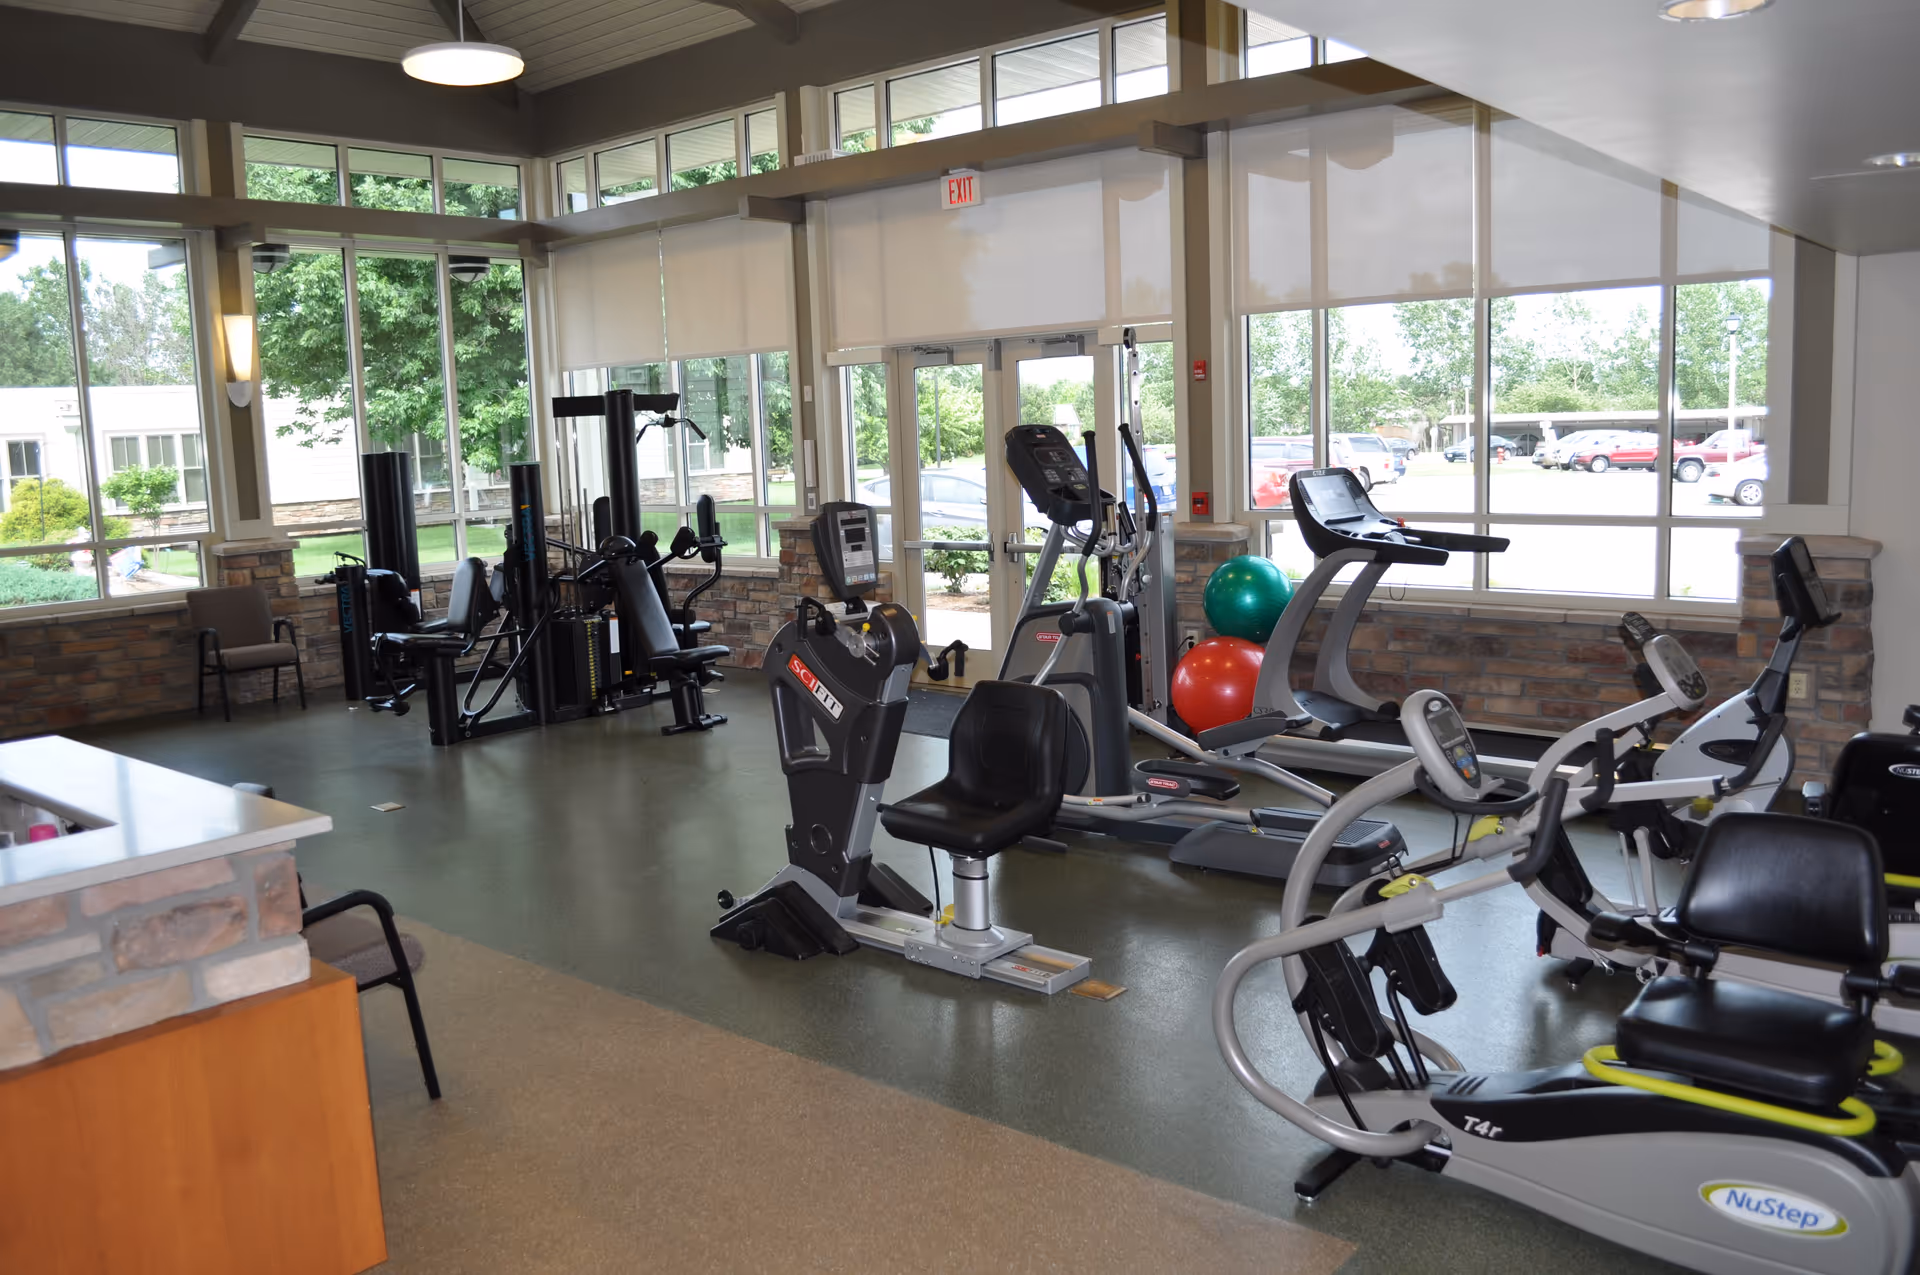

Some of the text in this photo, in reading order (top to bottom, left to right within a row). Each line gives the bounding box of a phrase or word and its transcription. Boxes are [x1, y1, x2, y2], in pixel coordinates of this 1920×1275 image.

[948, 176, 973, 205] EXIT
[341, 585, 354, 633] VECTRA
[791, 660, 841, 711] SCIFIT
[1464, 1115, 1502, 1138] T4r
[1725, 1189, 1820, 1229] NuStep
